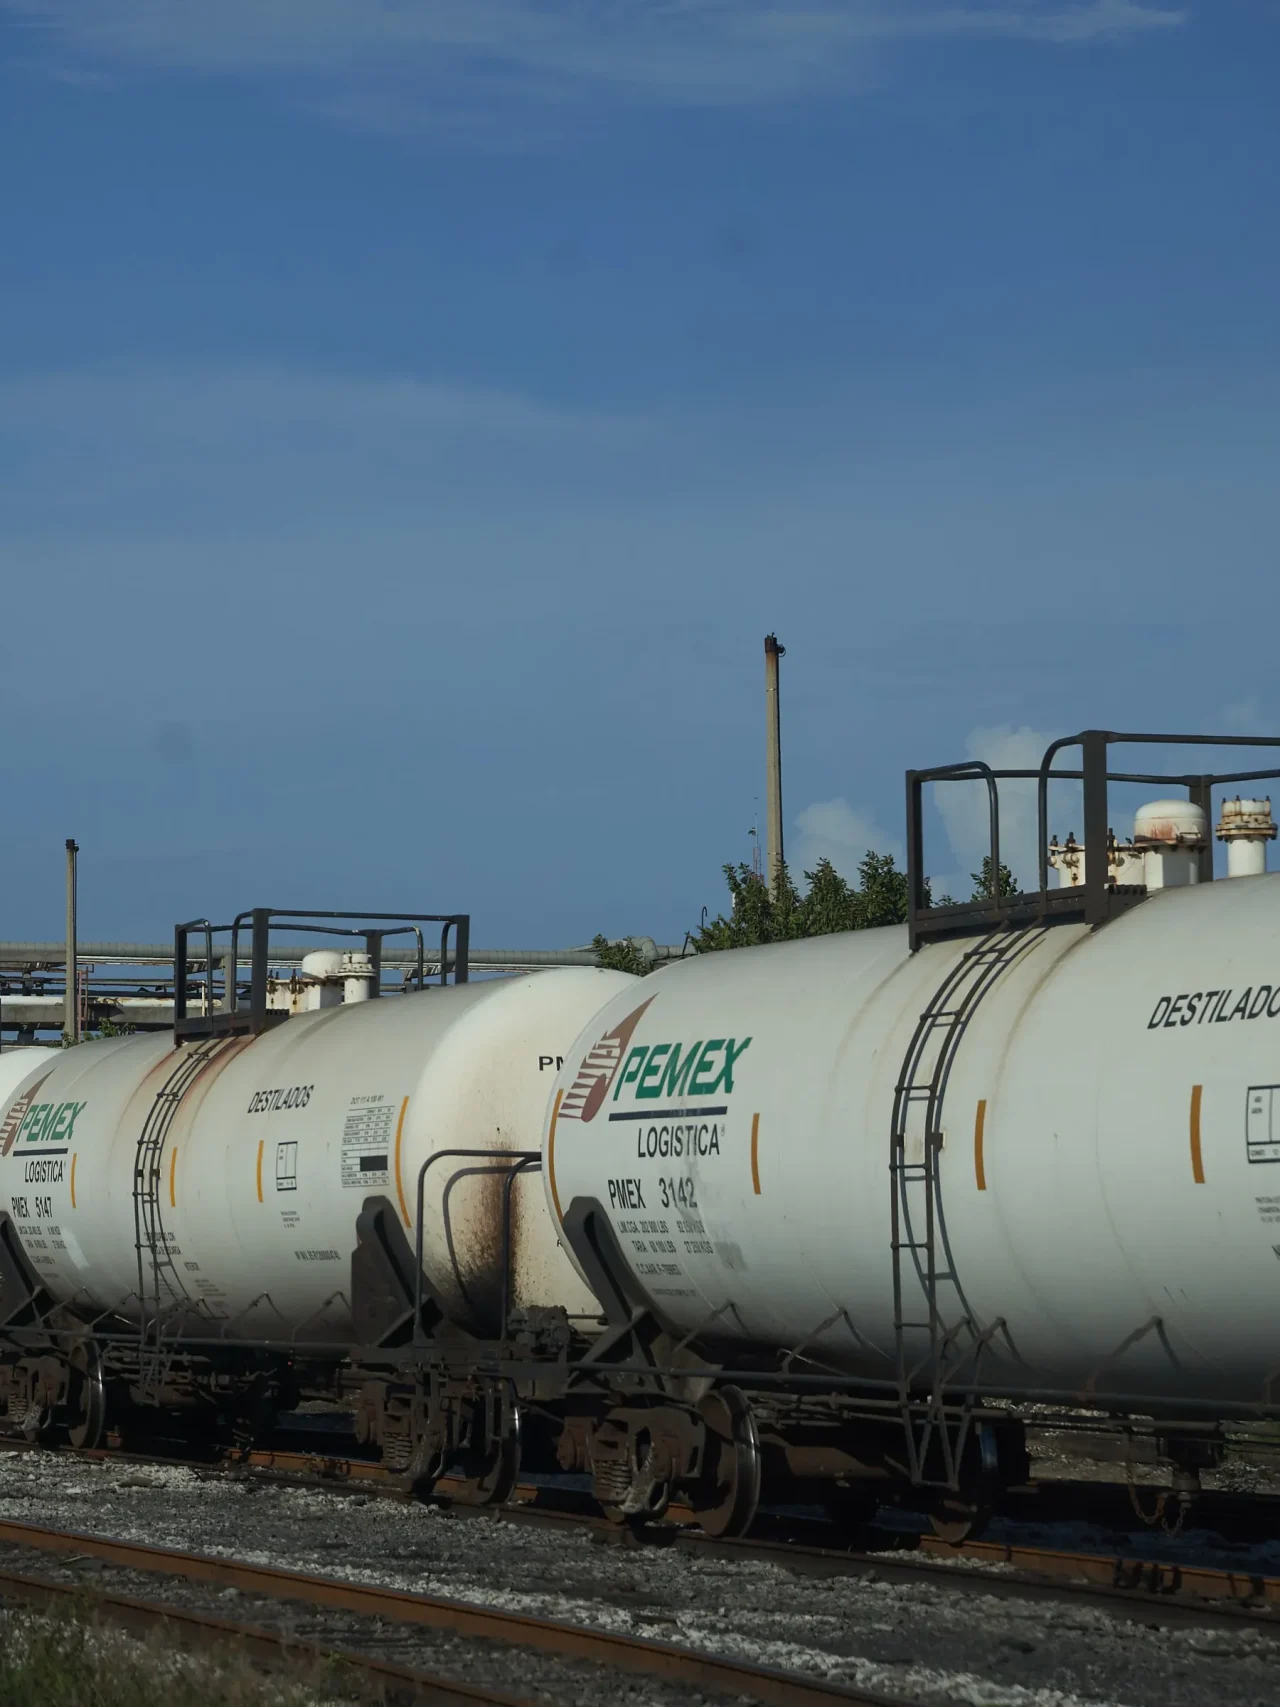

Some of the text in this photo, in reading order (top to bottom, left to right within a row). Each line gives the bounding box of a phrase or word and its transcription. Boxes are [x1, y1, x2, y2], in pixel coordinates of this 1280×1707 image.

[613, 1037, 753, 1101] PEMEX
[247, 1084, 314, 1114] DESTILADOS
[16, 1101, 87, 1143] PEMEX
[638, 1123, 720, 1158] LOGISTICA
[25, 1160, 63, 1183] LOGISTICA
[12, 1196, 30, 1217] PMEX
[608, 1177, 697, 1209] PMEX 3142
[631, 1240, 648, 1253] TARA
